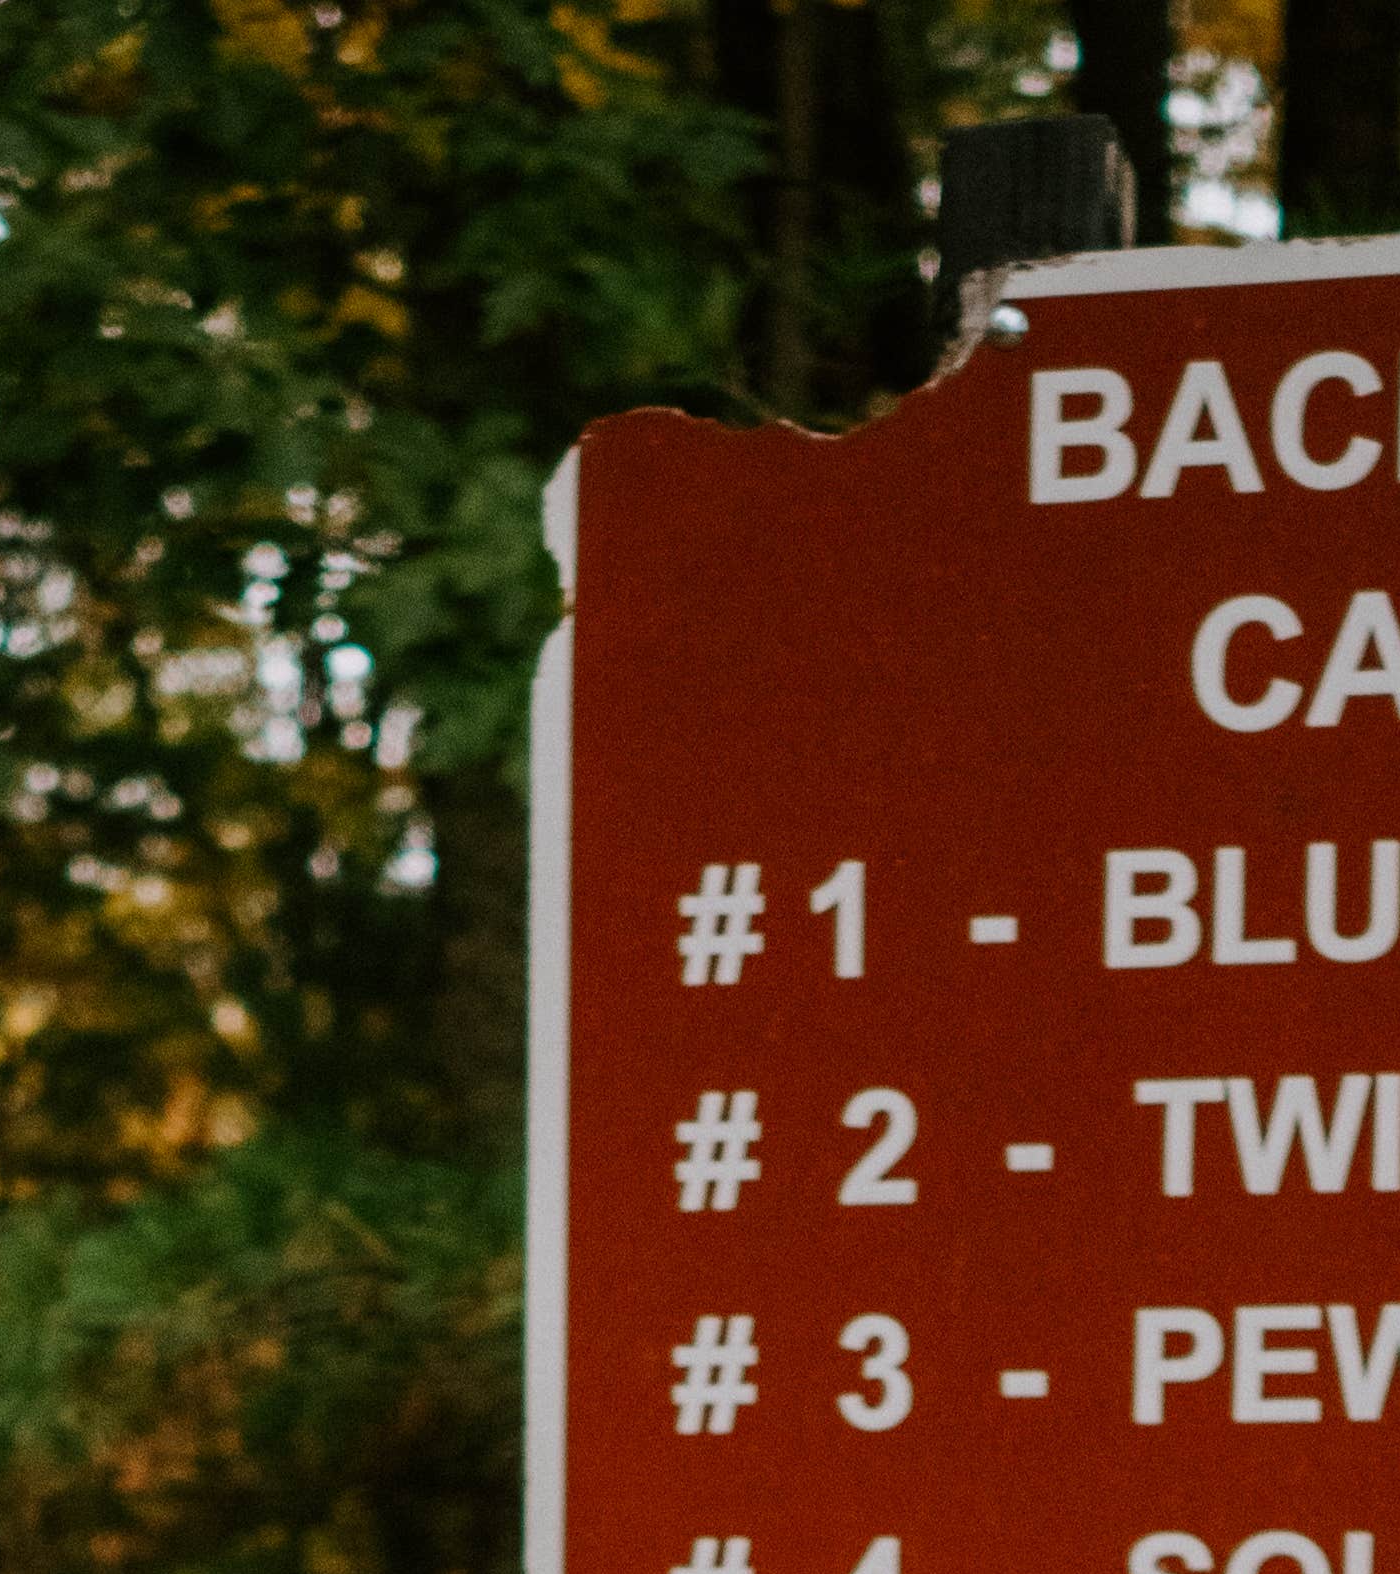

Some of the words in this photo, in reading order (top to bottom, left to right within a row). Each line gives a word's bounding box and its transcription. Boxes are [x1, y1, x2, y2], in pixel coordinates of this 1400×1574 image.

[678, 863, 765, 986] #
[810, 860, 865, 979] 1
[970, 916, 1017, 943] -
[674, 1090, 762, 1212] #
[838, 1087, 917, 1206] 2
[1006, 1143, 1053, 1171] -
[671, 1315, 759, 1435] #
[837, 1313, 913, 1431] 3
[1000, 1370, 1049, 1398] -
